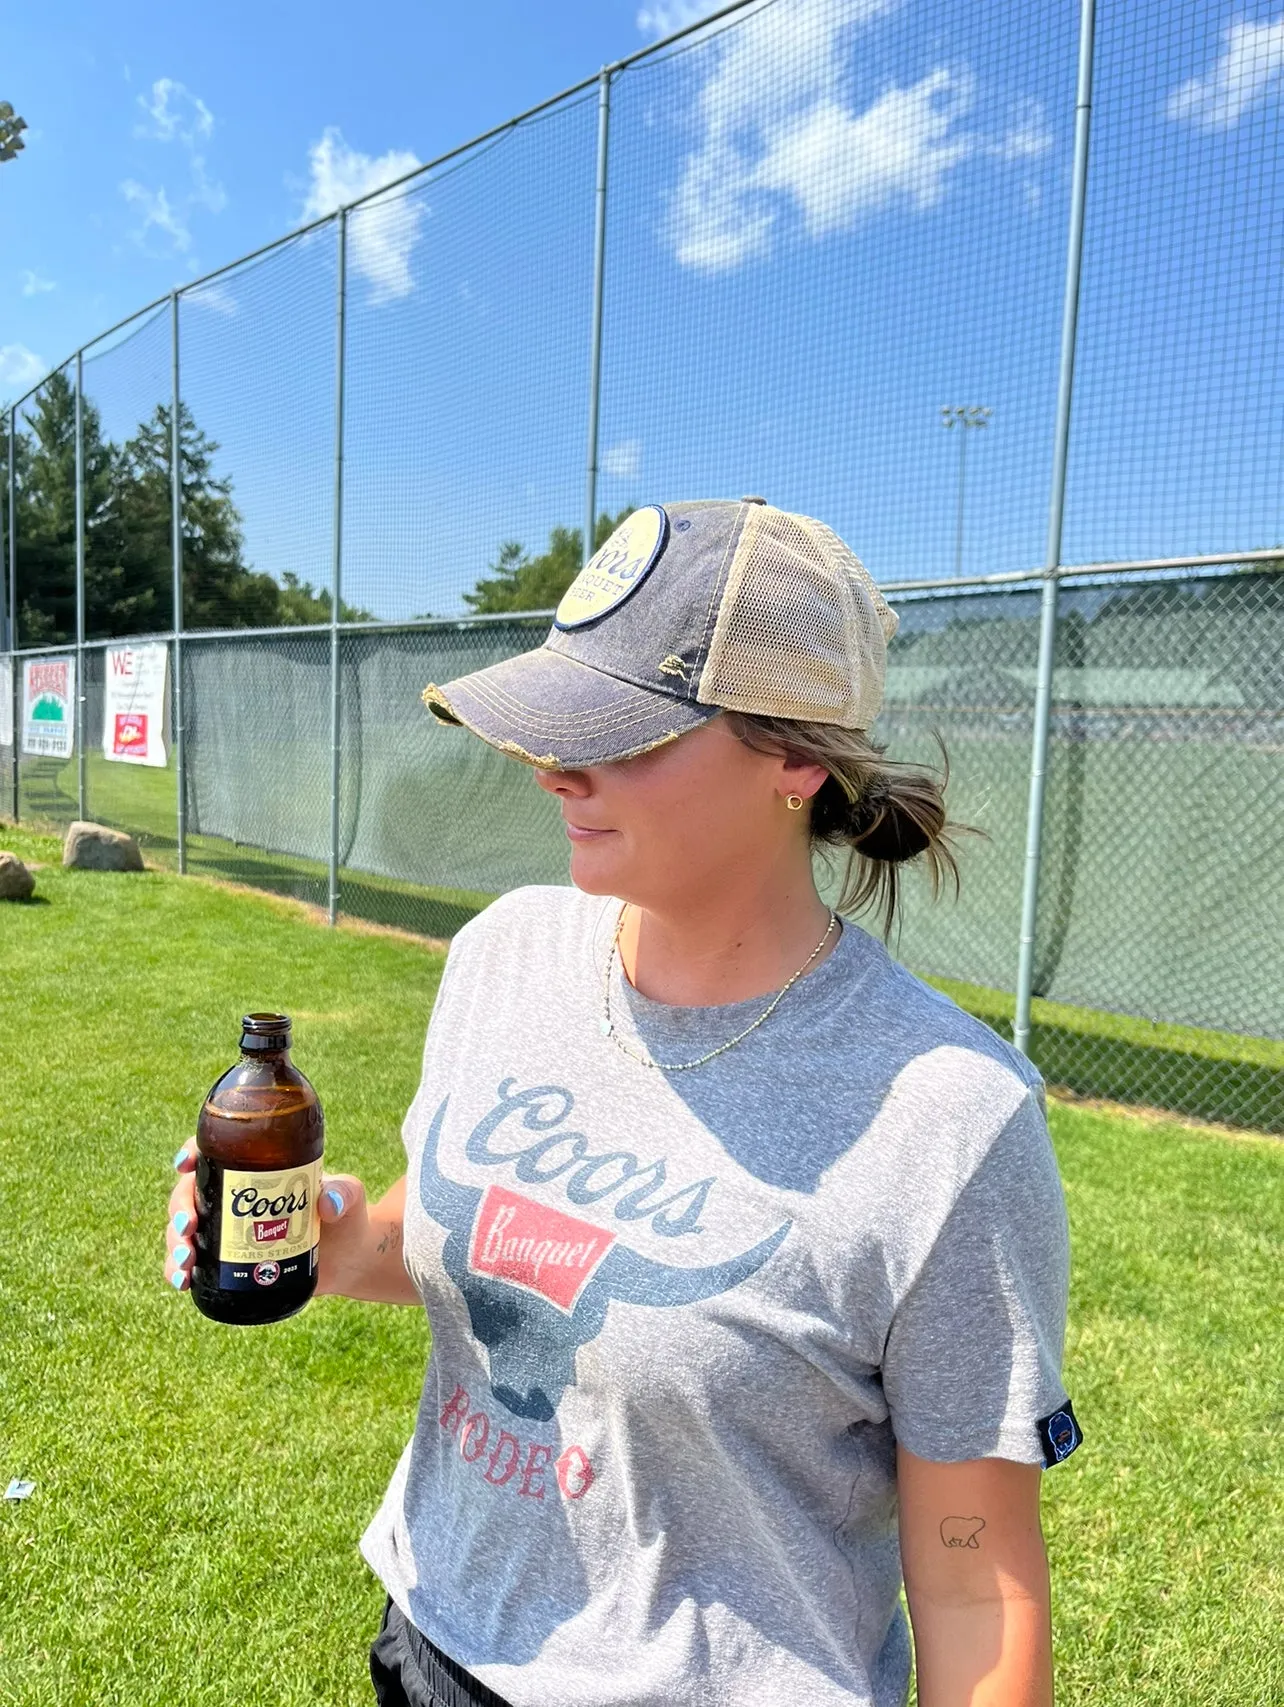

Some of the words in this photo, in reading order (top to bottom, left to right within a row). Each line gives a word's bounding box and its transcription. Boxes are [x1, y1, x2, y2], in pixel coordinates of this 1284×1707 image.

[587, 548, 645, 580] ors
[579, 573, 624, 596] QUET
[112, 651, 133, 676] WE
[464, 1076, 718, 1238] Coors
[231, 1187, 309, 1218] Coors
[257, 1220, 287, 1241] Banquet
[482, 1204, 599, 1279] Banquet
[227, 1250, 264, 1259] YEARS
[267, 1242, 308, 1257] STRONG
[438, 1384, 596, 1500] RODEO
